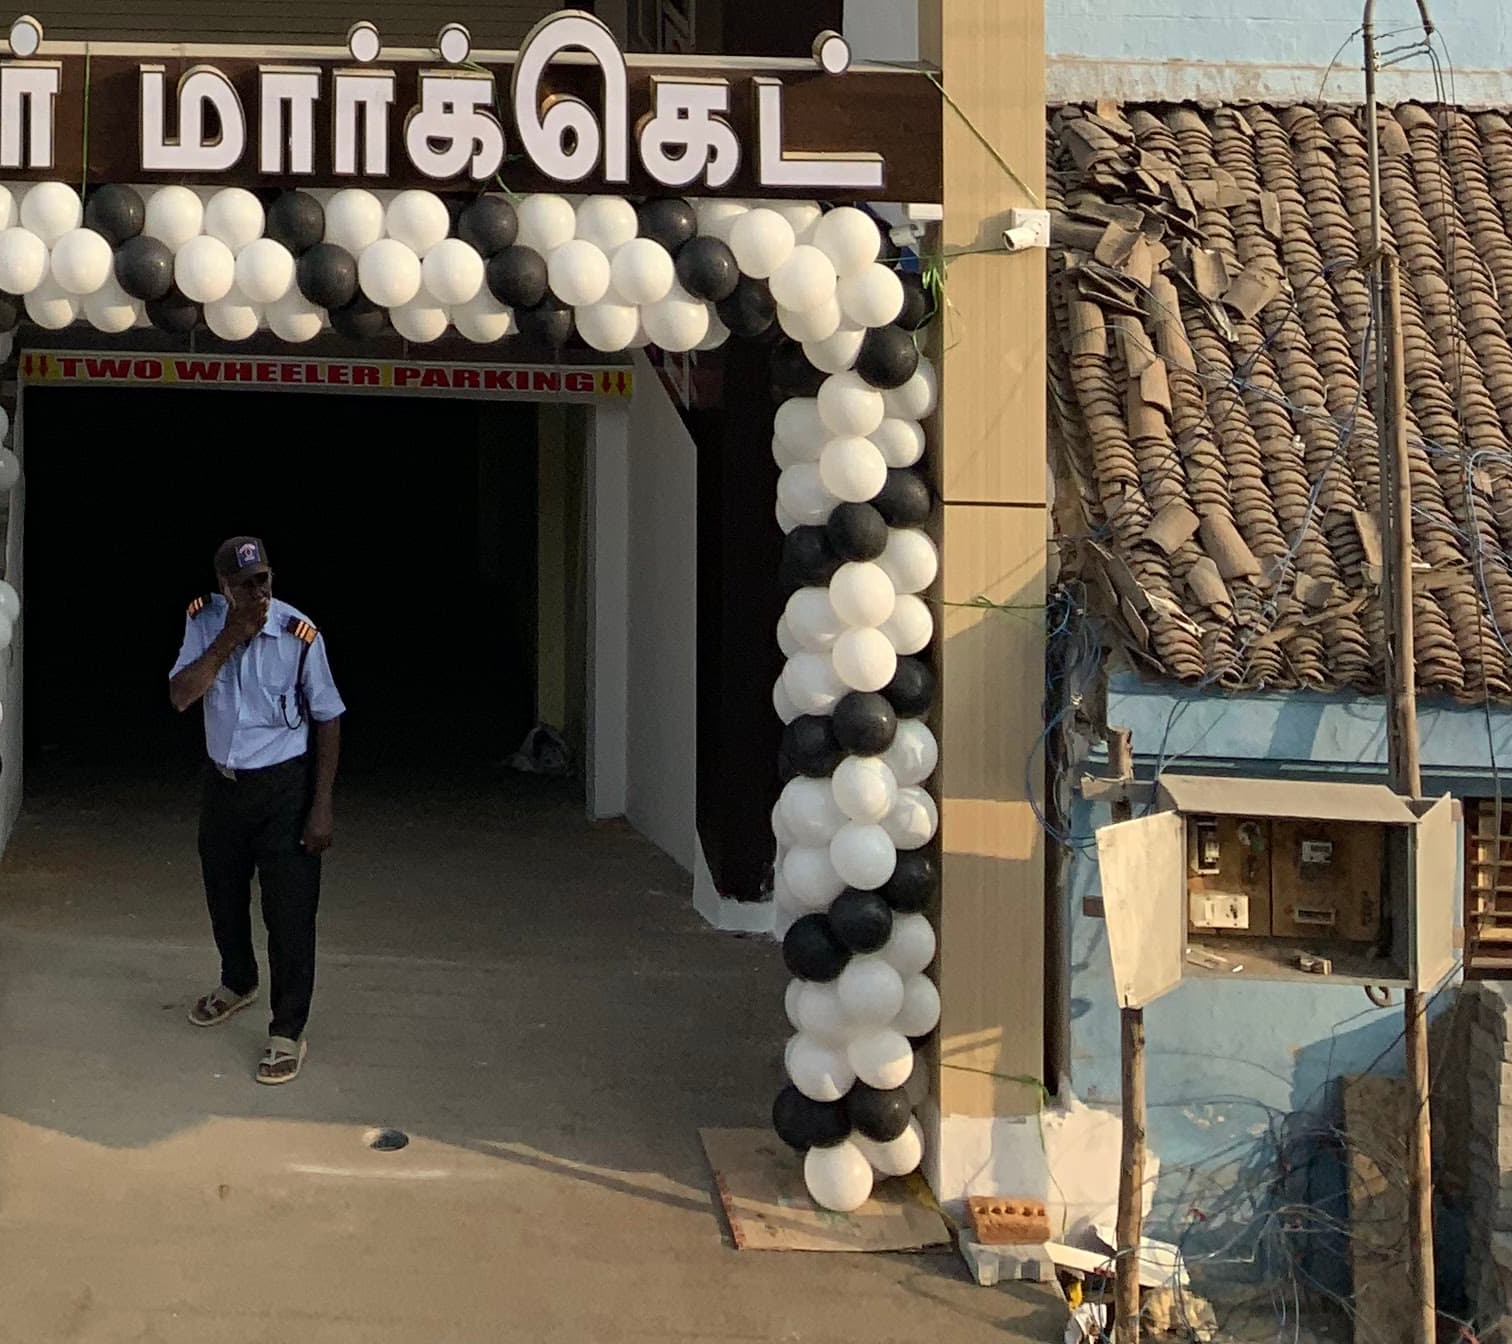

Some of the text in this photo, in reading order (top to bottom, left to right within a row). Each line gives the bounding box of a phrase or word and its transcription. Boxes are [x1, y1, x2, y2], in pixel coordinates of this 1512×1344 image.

[140, 9, 885, 190] மார்க்கெட்
[55, 356, 596, 393] TWO WHEELER PARKING
